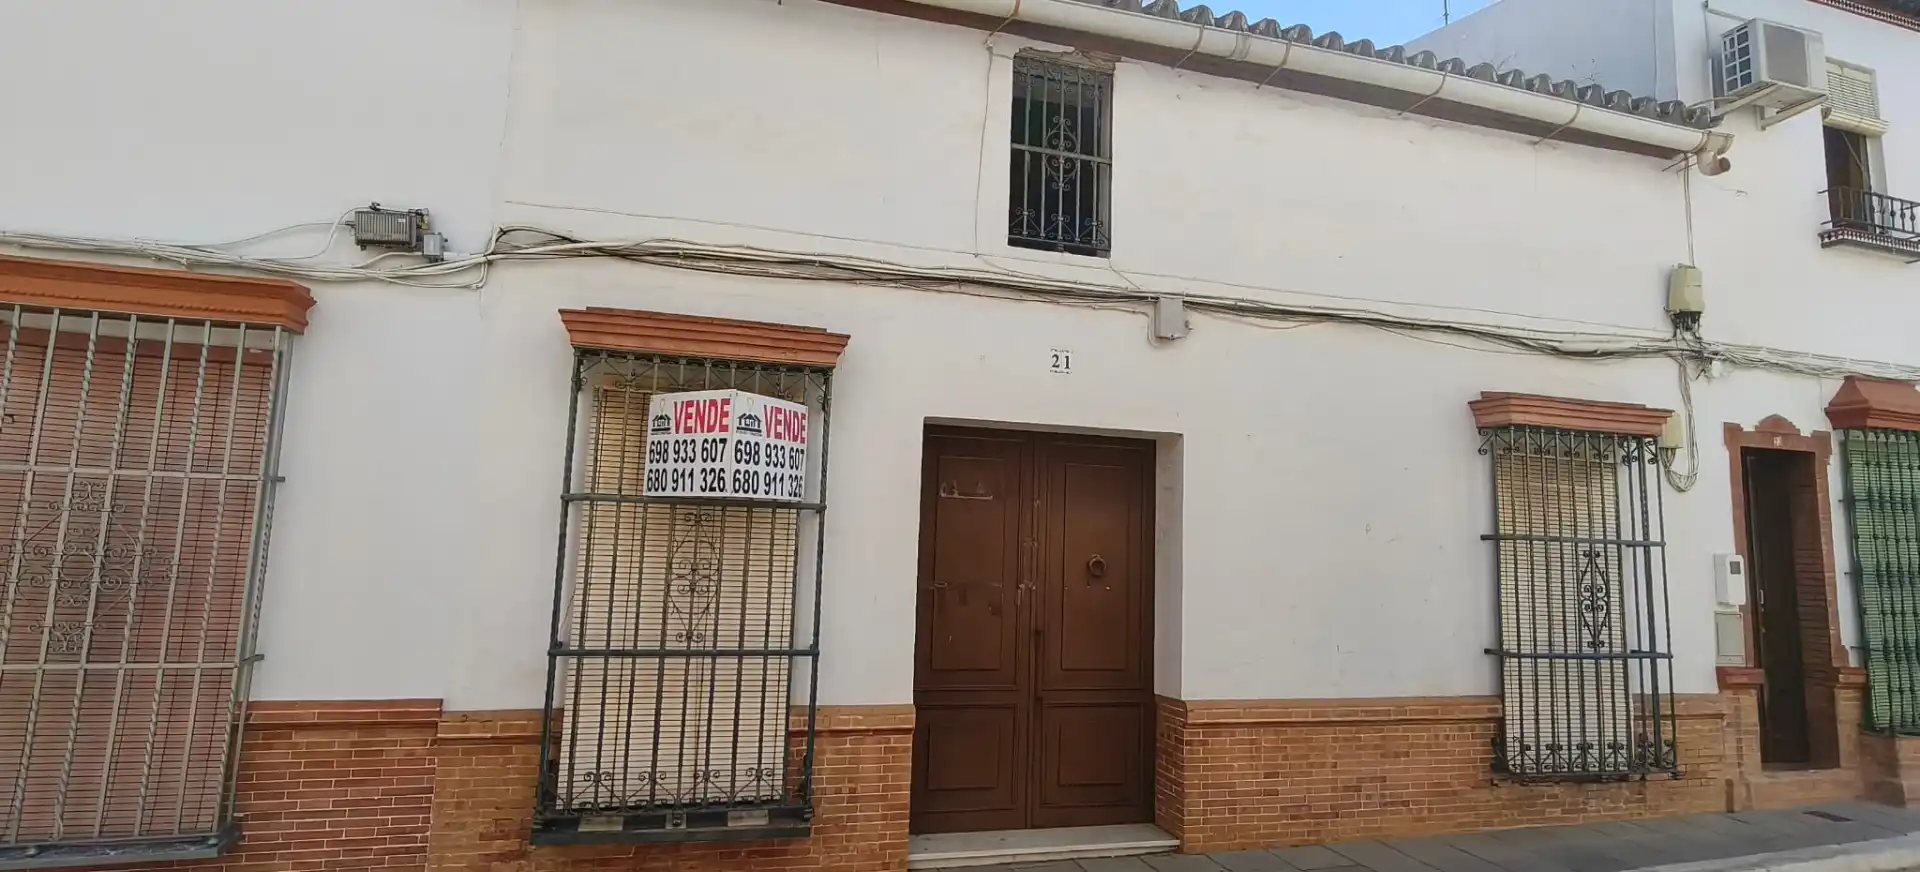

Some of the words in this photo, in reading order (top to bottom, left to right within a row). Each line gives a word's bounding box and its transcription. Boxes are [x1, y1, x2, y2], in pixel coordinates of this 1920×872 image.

[1051, 353, 1070, 369] 21
[674, 398, 731, 434] VENDE
[763, 404, 807, 445] VENDE
[649, 440, 669, 464] 698
[673, 439, 696, 464] 933
[701, 438, 728, 463] 607
[734, 439, 760, 466] 698
[765, 443, 786, 468] 933
[788, 447, 805, 472] 607
[647, 468, 668, 493] 680
[671, 468, 695, 493] 911
[700, 468, 726, 493] 326
[732, 468, 759, 495] 680
[763, 471, 785, 497] 911
[788, 474, 803, 498] 326
